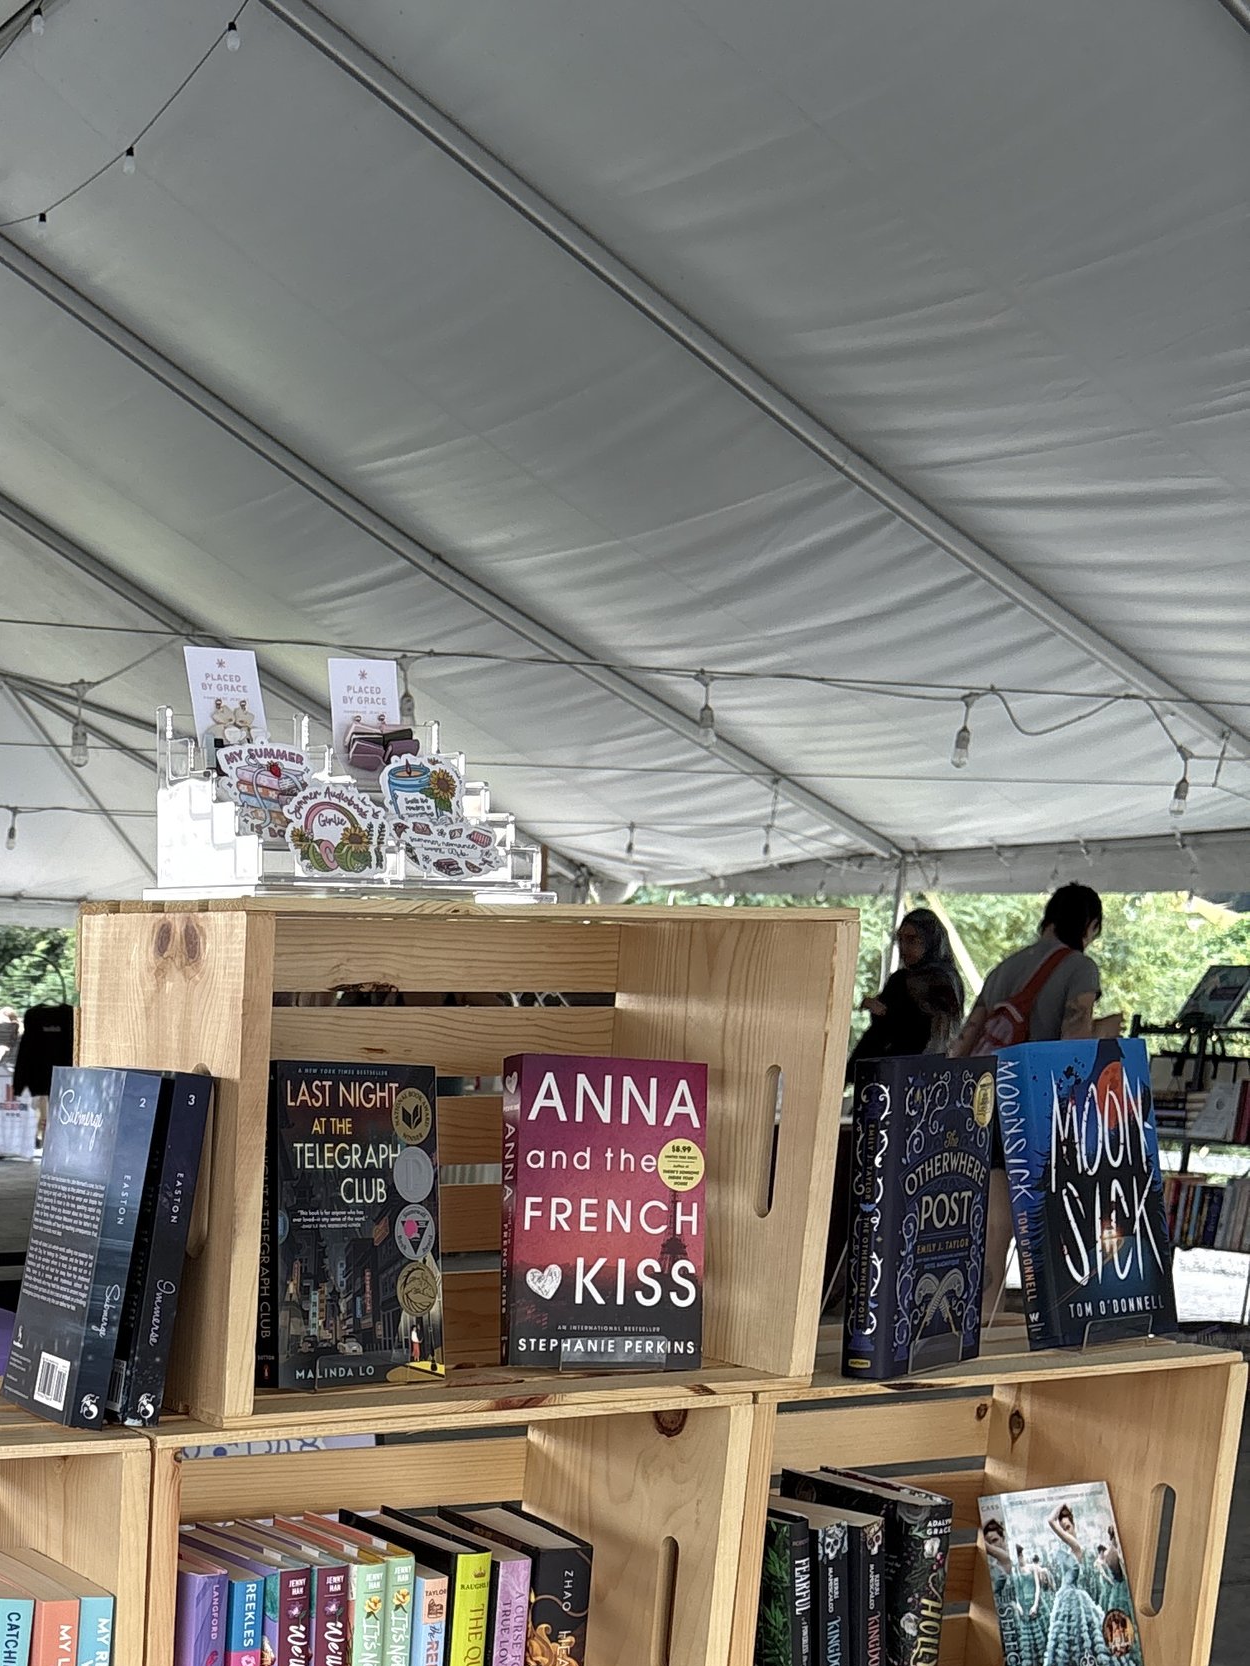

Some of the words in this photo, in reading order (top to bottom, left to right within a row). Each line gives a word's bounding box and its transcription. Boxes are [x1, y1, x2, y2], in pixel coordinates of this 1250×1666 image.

[201, 683, 212, 691] BY
[216, 684, 248, 693] GRACE
[205, 673, 241, 683] PLACED
[347, 685, 381, 694] PLACED
[342, 696, 354, 704] BY
[357, 697, 386, 705] GRACE
[224, 750, 242, 765] MY
[250, 748, 304, 766] SUMMER
[139, 1098, 147, 1108] 2
[188, 1094, 196, 1106] 3
[286, 1080, 332, 1107] LAST
[339, 1081, 399, 1108] NIGHT
[527, 1071, 701, 1129] ANNA
[312, 1118, 327, 1135] AT
[330, 1118, 352, 1135] THE
[996, 1059, 1034, 1204] MOONSICK
[293, 1143, 401, 1169] TELEGRAPH
[526, 1147, 591, 1171] and
[605, 1147, 657, 1173] the
[905, 1151, 988, 1196] OTHERWHERE
[117, 1174, 132, 1226] EASTON
[170, 1172, 185, 1224] EASTON
[340, 1178, 387, 1204] CLUB
[523, 1196, 698, 1236] FRENCH
[919, 1190, 973, 1231] POST
[1016, 1210, 1029, 1238] TOM
[1060, 1169, 1165, 1286] SICK
[859, 1236, 869, 1299] OTHERWHERE
[1019, 1239, 1038, 1303] O'DONNELL
[574, 1257, 697, 1308] KISS
[1069, 1302, 1093, 1319] TOM
[1099, 1294, 1165, 1316] O'DONNELL
[518, 1338, 615, 1353] STEPHANIE
[624, 1340, 695, 1354] PERKINS
[296, 1368, 354, 1381] MALINDA
[359, 1366, 375, 1377] LO
[981, 1504, 1000, 1512] CASS
[288, 1578, 307, 1588] JENNY
[325, 1575, 345, 1584] JENNY
[561, 1569, 574, 1612] ZHAO
[794, 1557, 811, 1615] FEARFUL
[211, 1584, 220, 1640] LANGFORD
[243, 1583, 257, 1648] REEKLES
[468, 1603, 485, 1642] THE
